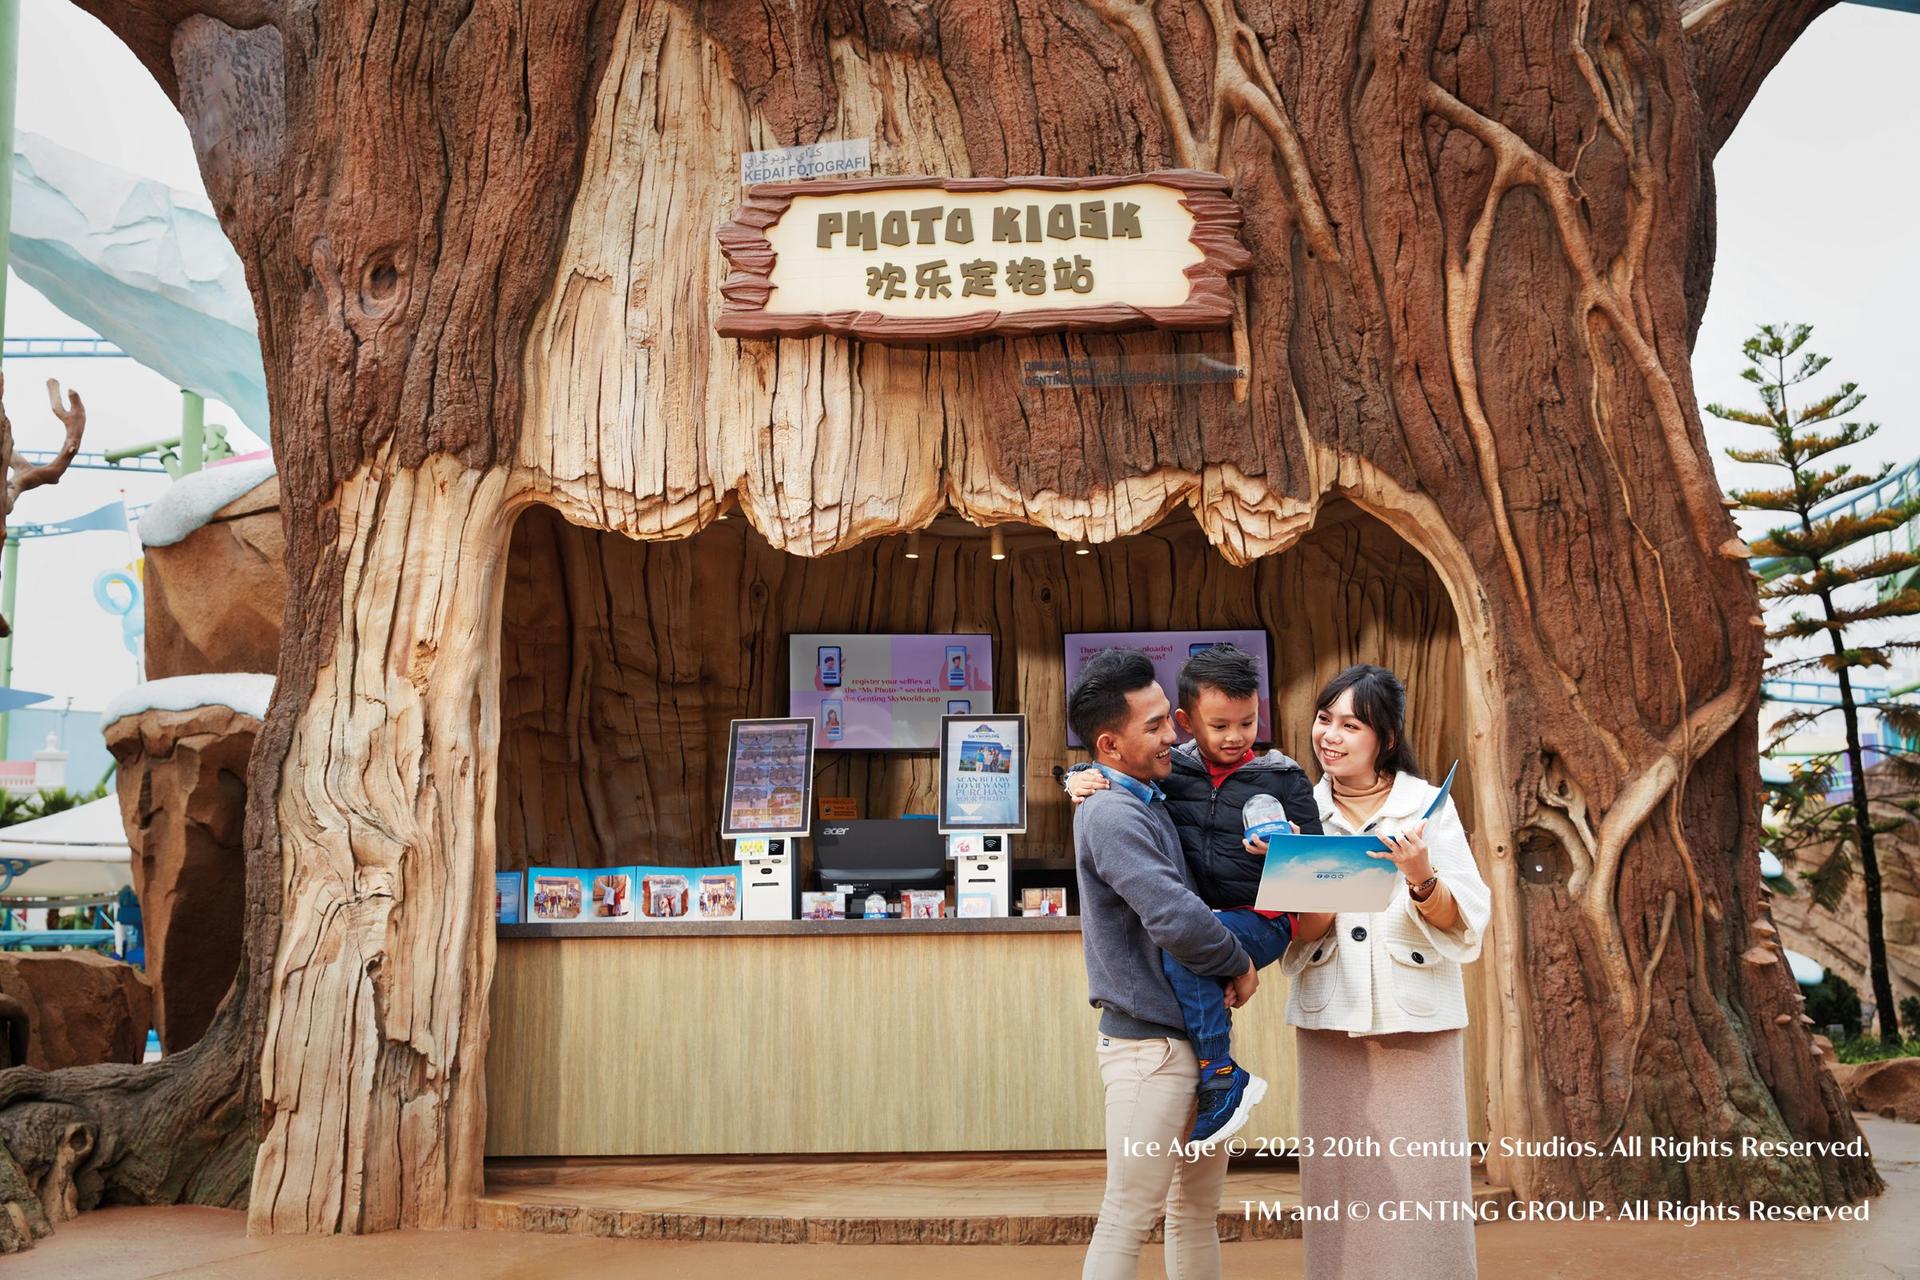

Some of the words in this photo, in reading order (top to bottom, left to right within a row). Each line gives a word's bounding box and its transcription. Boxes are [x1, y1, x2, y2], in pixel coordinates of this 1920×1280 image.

[744, 167, 784, 182] KEDAI
[788, 157, 866, 176] FOTOGRAFI
[816, 205, 974, 250] PHOTO
[992, 200, 1142, 243] KIOSK
[866, 254, 1094, 300] 欢乐定格站
[1025, 374, 1072, 386] GENTING
[851, 678, 880, 686] register
[857, 695, 886, 703] Genting
[887, 695, 926, 703] SkyWorlds
[955, 788, 1009, 796] PURCHASE
[823, 827, 850, 836] acer
